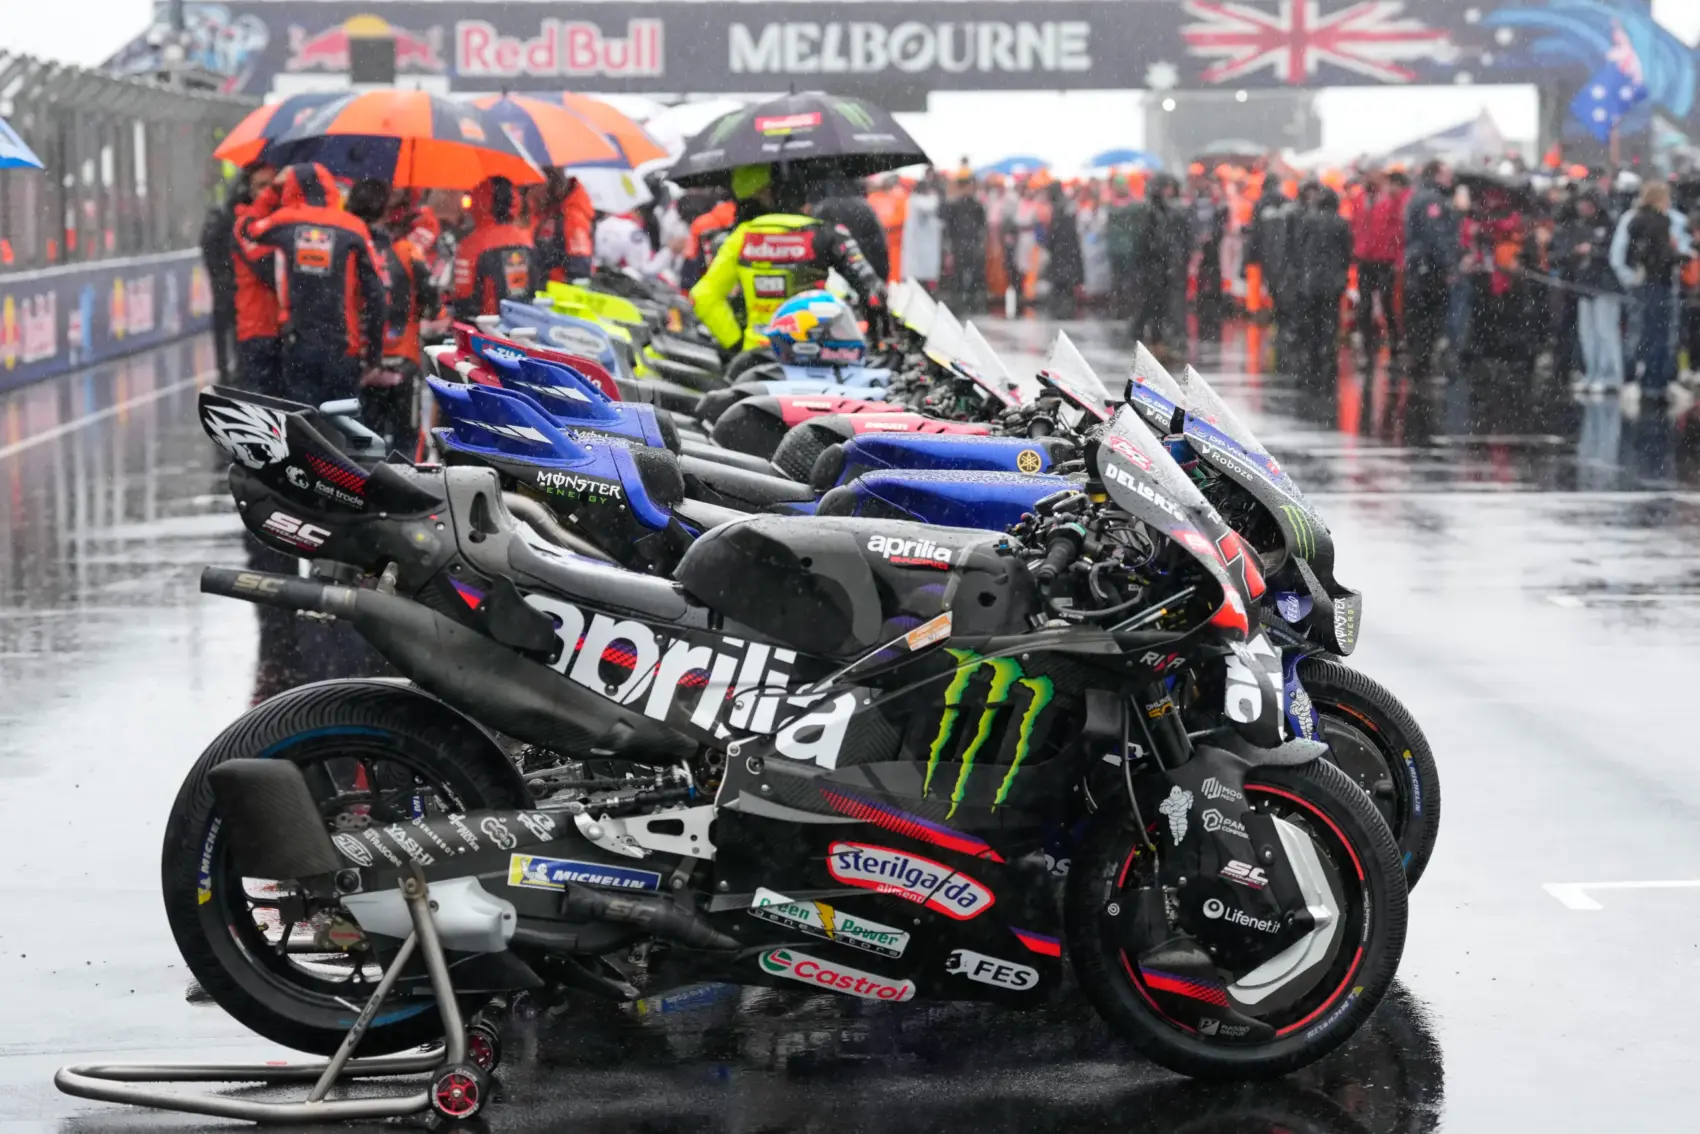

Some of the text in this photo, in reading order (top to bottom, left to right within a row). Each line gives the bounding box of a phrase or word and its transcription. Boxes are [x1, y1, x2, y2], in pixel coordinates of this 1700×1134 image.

[458, 23, 661, 72] Red Bull
[728, 21, 1092, 73] MELBOURNE
[1211, 451, 1254, 481] Roboze
[315, 480, 335, 496] fast
[336, 488, 365, 507] trade
[264, 511, 332, 545] SC
[866, 534, 953, 562] aprilia
[522, 593, 856, 770] aprilia
[1409, 766, 1422, 812] MICHELIN
[1222, 818, 1246, 832] PAN
[200, 817, 222, 875] MICHEL
[552, 869, 647, 889] MICHELIN
[838, 849, 978, 909] sterilgarda
[1223, 860, 1269, 884] SC
[840, 918, 900, 946] Power
[1224, 907, 1281, 934] Lifenet.it
[793, 960, 909, 1001] Castrol
[973, 960, 1032, 987] FES
